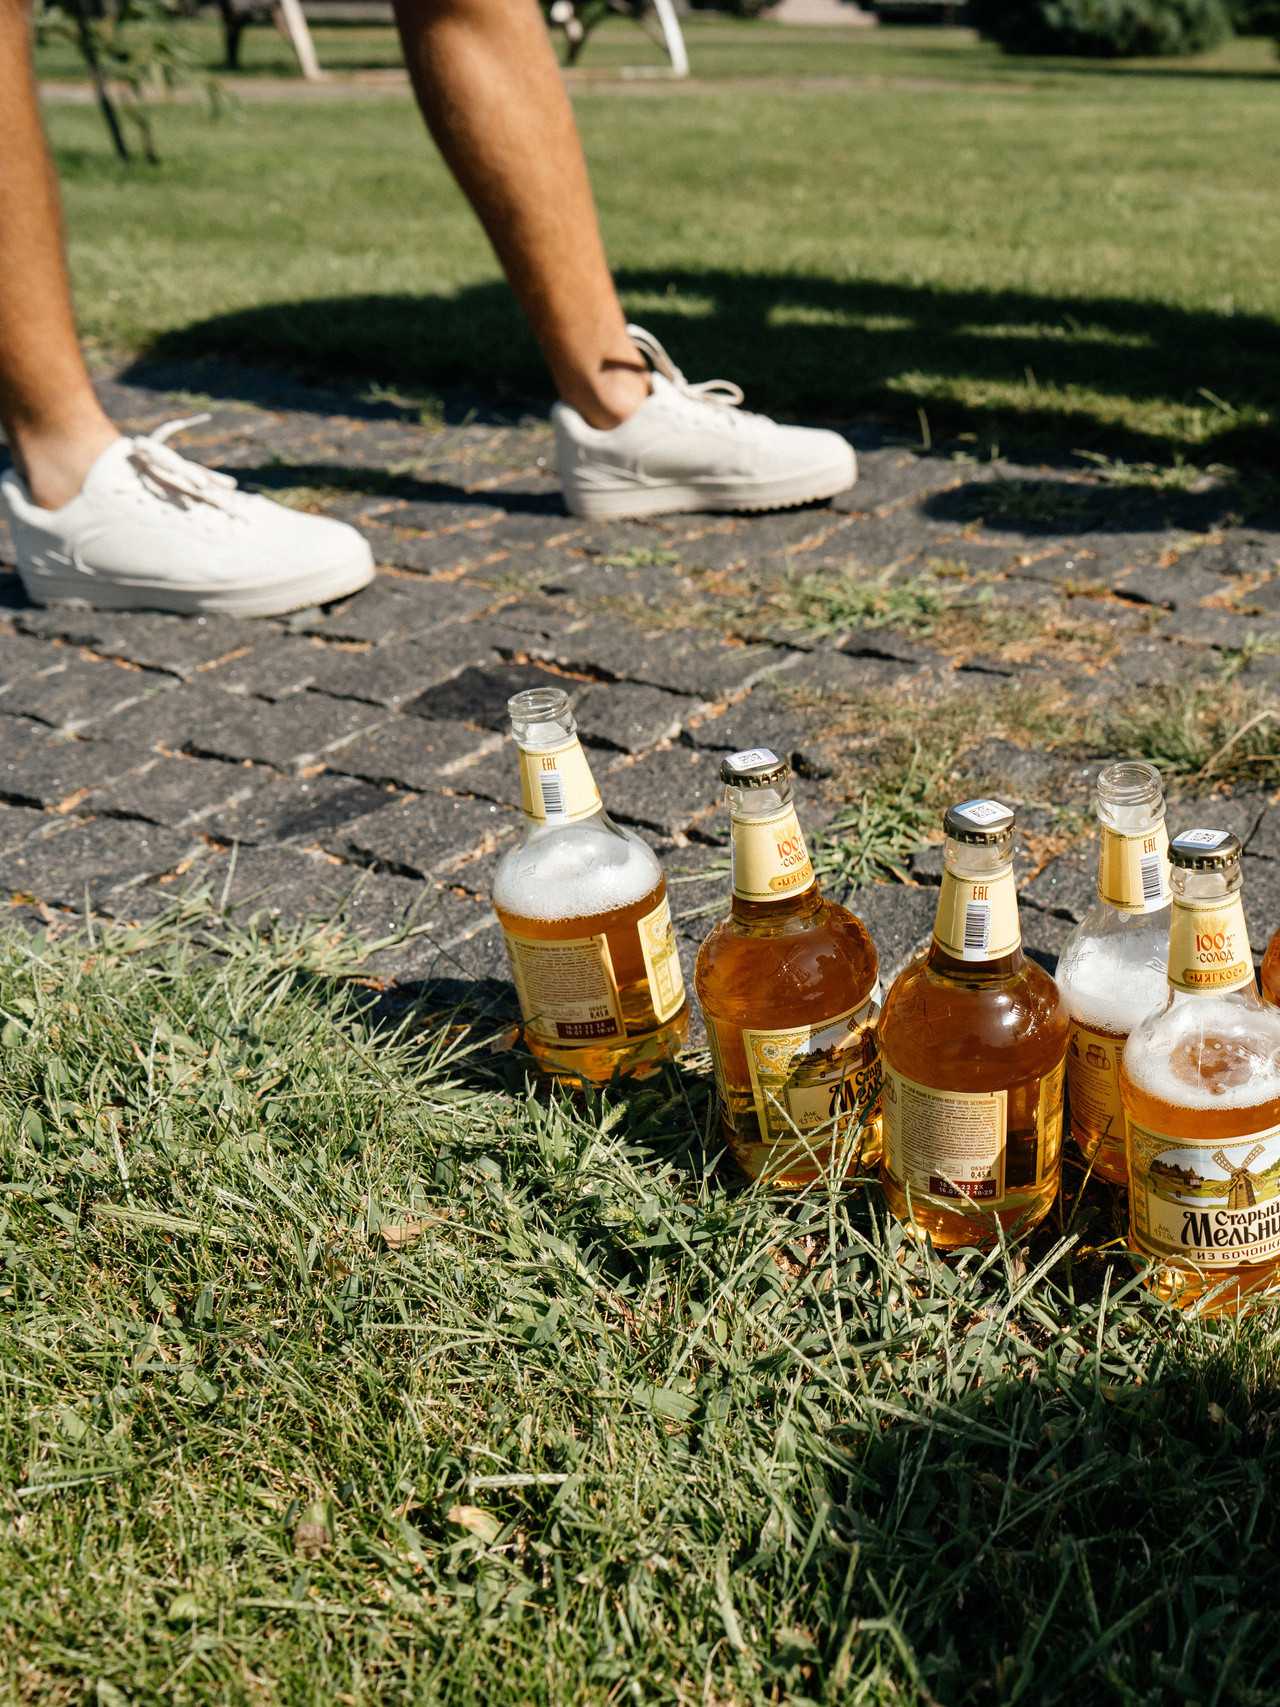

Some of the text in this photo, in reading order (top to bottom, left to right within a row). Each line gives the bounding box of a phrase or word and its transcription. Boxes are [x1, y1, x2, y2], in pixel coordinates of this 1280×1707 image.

[541, 757, 557, 771] EAC
[1143, 837, 1157, 854] EAC
[973, 886, 989, 900] EAC
[1199, 950, 1234, 963] СОЛОД
[1194, 968, 1238, 982] МЯГКОЕ
[1214, 1200, 1280, 1227] Старый
[1197, 1251, 1216, 1260] ИЗ
